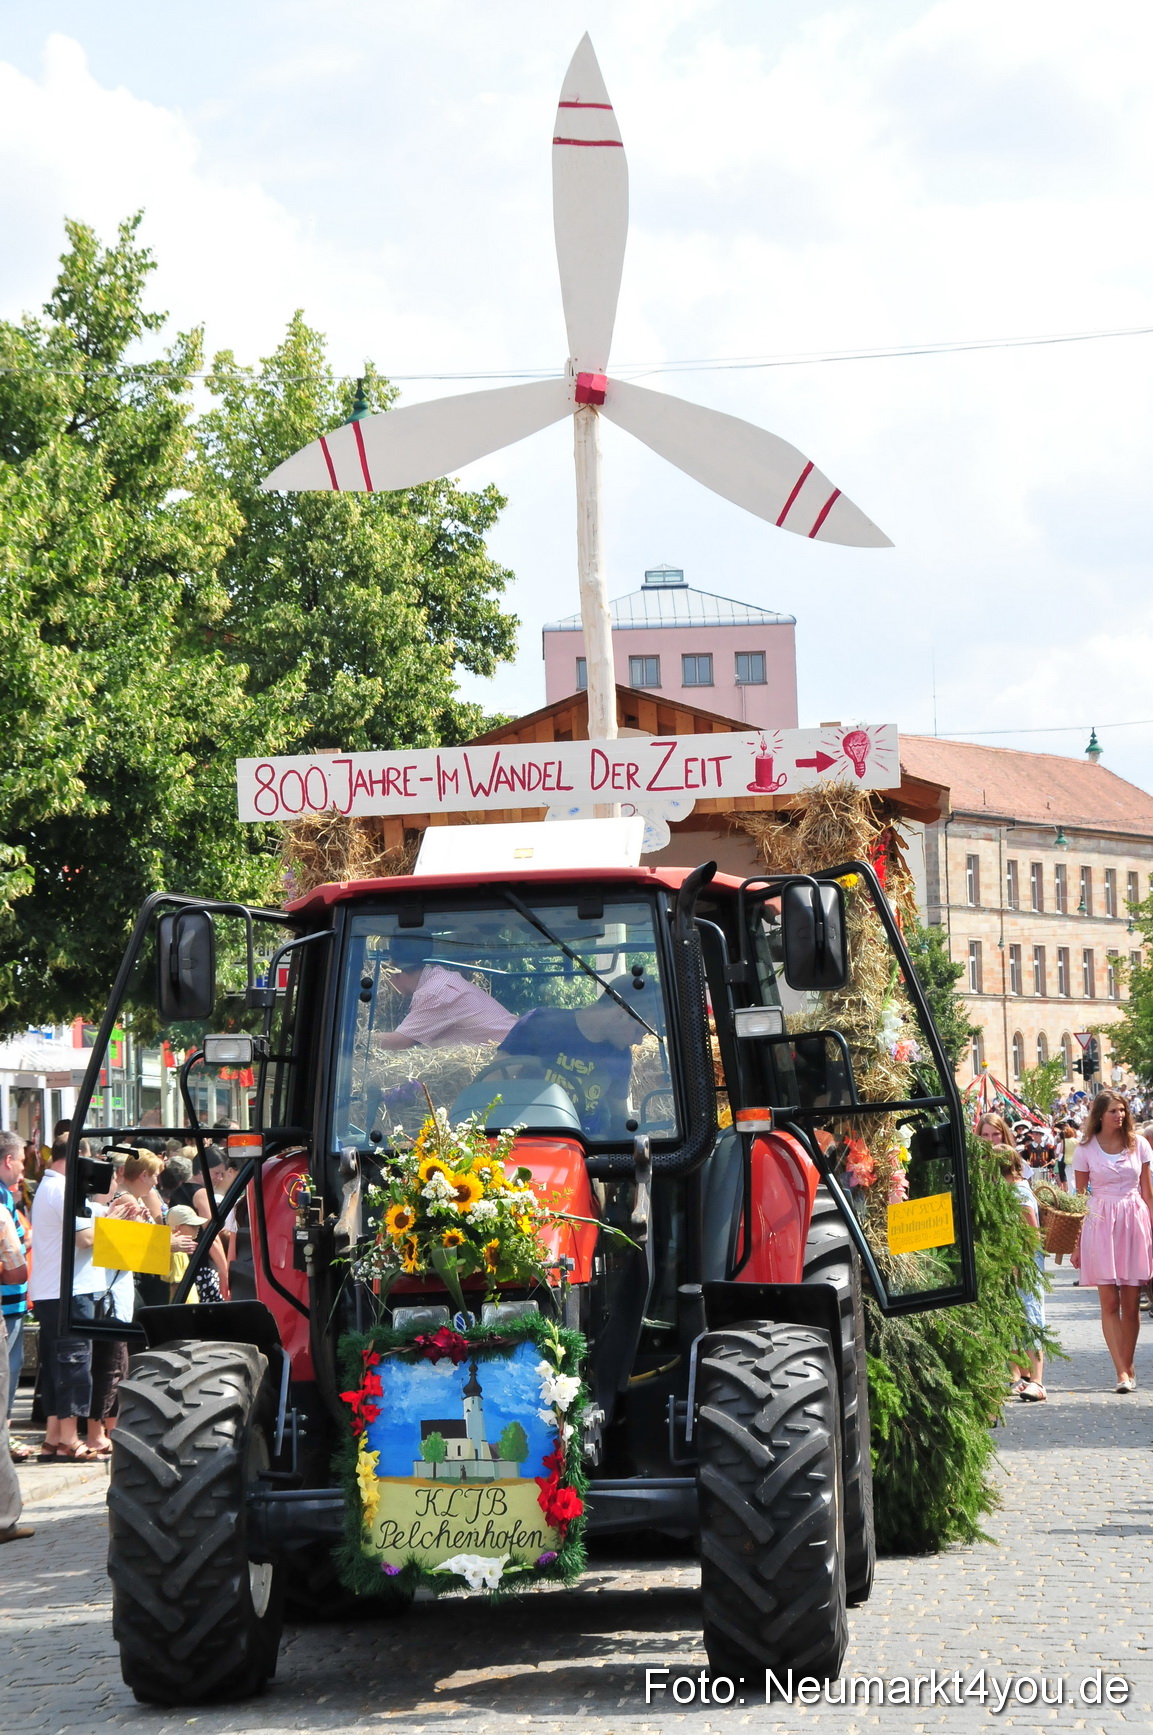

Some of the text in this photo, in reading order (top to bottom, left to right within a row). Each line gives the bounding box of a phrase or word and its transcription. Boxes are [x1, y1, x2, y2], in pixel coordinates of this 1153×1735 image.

[254, 763, 328, 815] 800
[463, 751, 574, 798] WANDEL
[590, 748, 641, 791] DER
[646, 741, 733, 792] ZEIT
[414, 1487, 508, 1524] KLJB
[375, 1519, 546, 1553] Pelchenhofen
